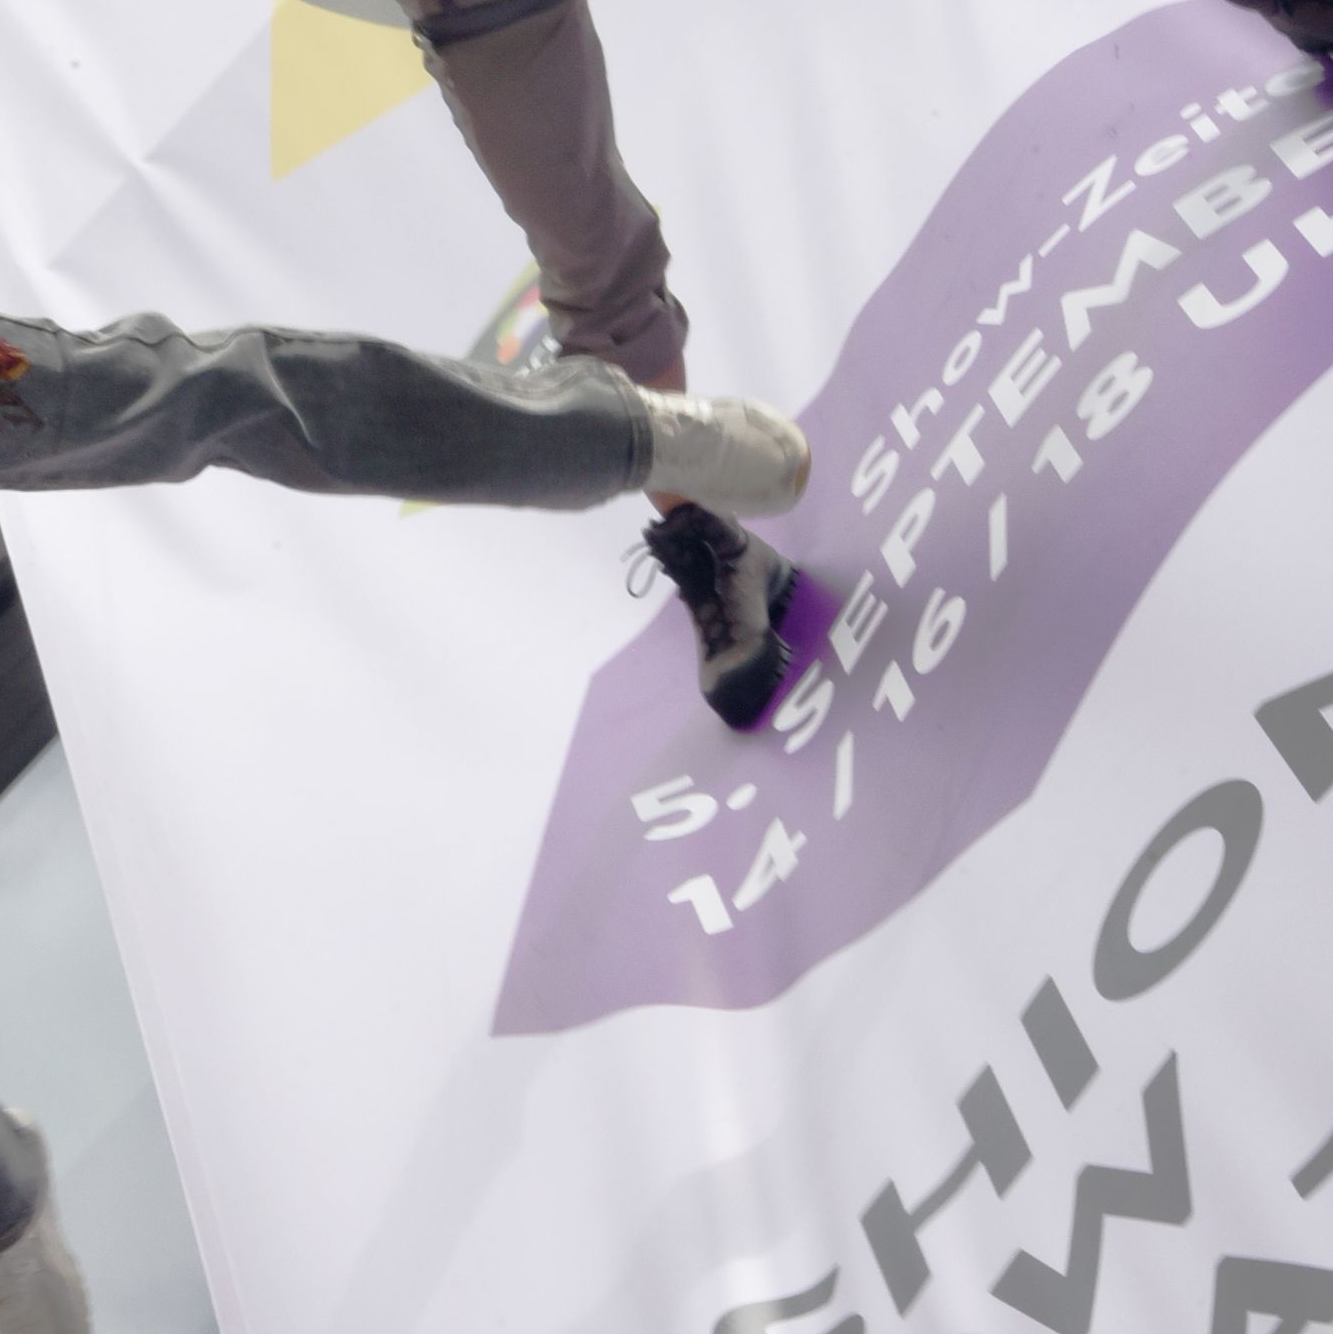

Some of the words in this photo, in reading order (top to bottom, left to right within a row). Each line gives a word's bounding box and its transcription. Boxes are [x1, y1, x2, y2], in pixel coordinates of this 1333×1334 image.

[666, 817, 807, 935] 14
[872, 587, 967, 724] 16
[1031, 350, 1155, 484] 18
[630, 773, 759, 841] 5.
